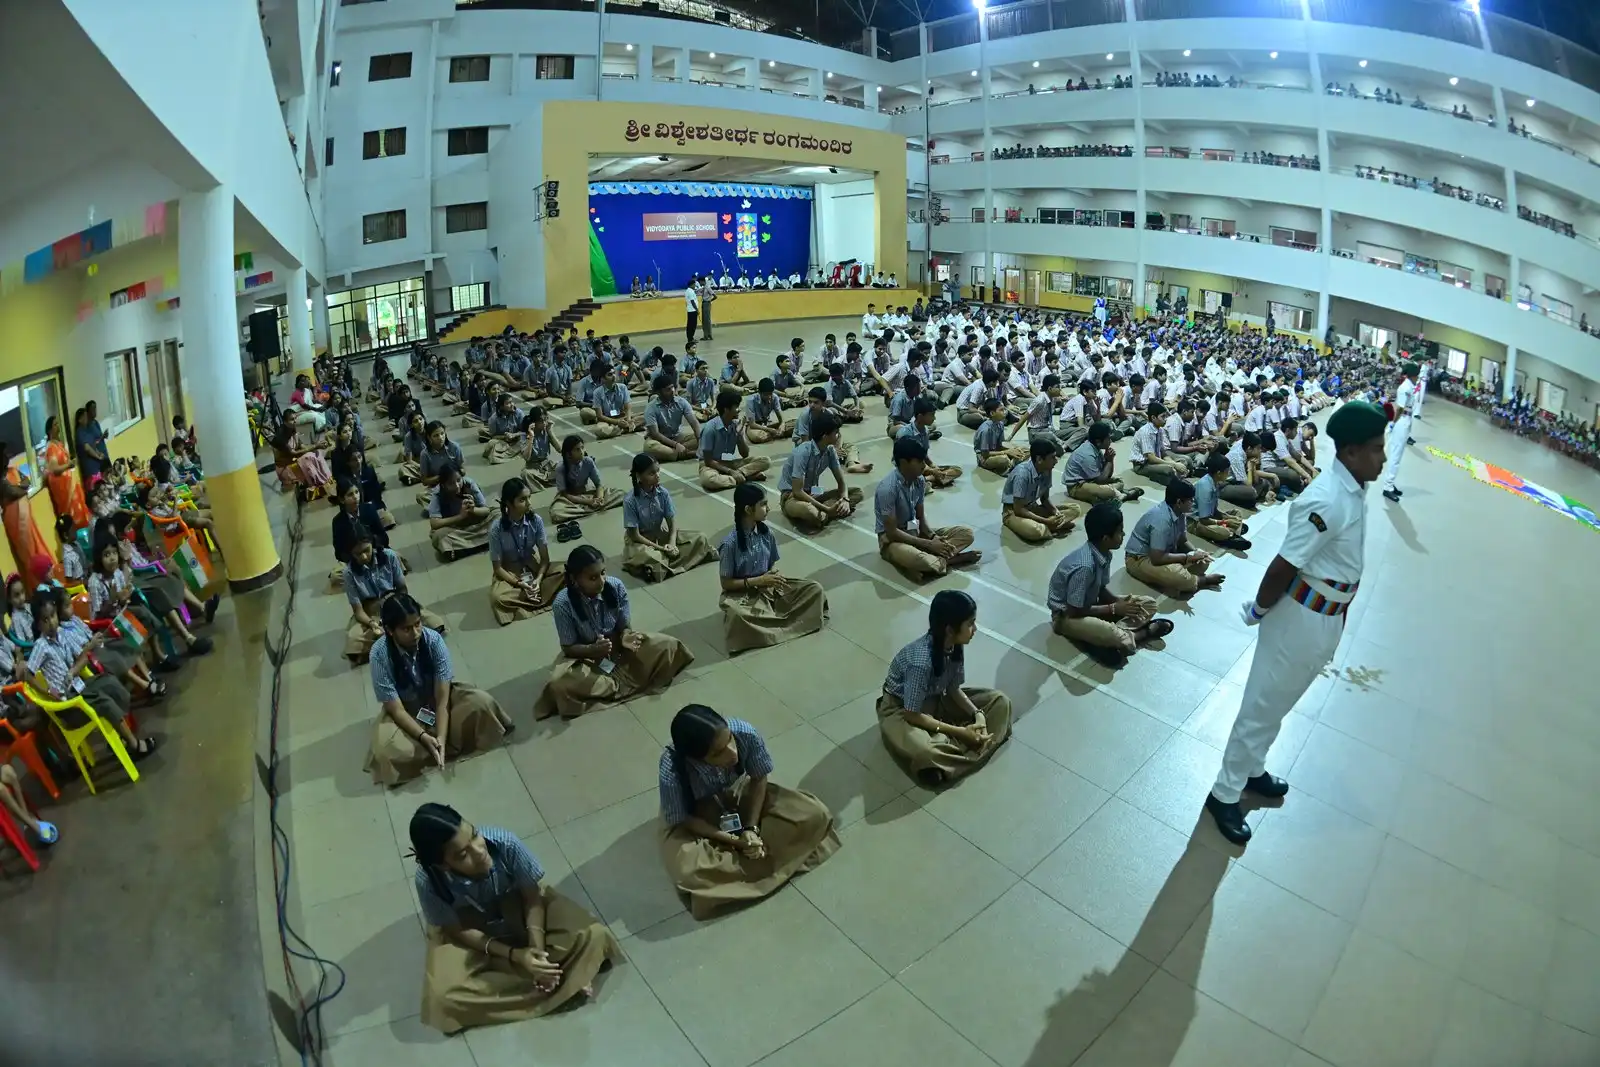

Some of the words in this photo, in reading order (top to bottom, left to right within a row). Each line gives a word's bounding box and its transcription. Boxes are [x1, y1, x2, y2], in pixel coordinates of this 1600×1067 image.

[625, 119, 651, 142] ಶ್ರೀ
[654, 121, 759, 146] ವಿಶ್ವೇಶತೀರ್ಥ
[762, 130, 853, 155] ರಂಗಮಂದಿರ
[645, 225, 676, 233] VIDYODAYA
[676, 224, 695, 232] PUBLIC
